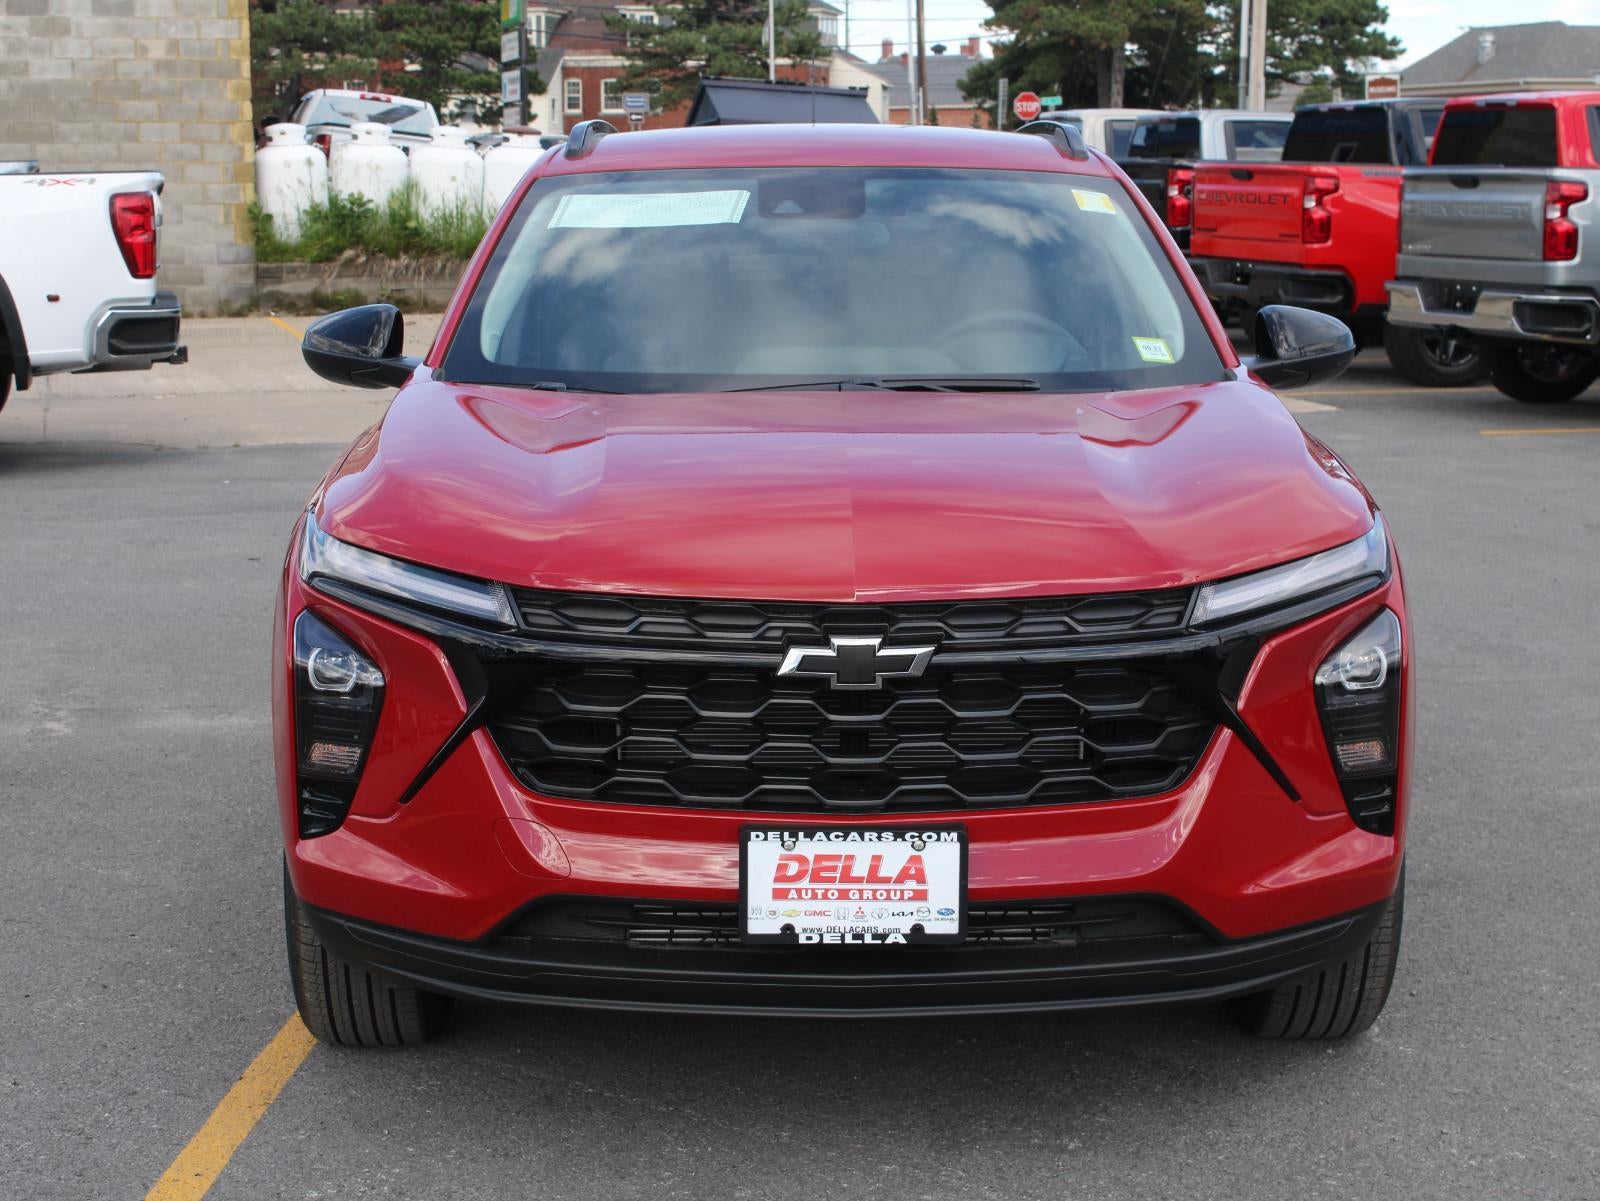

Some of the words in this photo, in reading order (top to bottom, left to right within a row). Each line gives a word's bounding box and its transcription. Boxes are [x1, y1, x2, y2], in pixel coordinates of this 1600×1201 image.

[1016, 101, 1040, 112] STOP
[1197, 190, 1289, 205] CHEVROLET
[1404, 201, 1529, 219] CHEVROLET
[750, 831, 958, 842] DELLACARS.COM
[772, 853, 928, 885] DELLA
[787, 889, 839, 900] AUTO
[848, 888, 914, 900] GROUP
[804, 909, 832, 917] GMC
[801, 925, 901, 934] www.DELLACARS.com
[799, 933, 908, 944] DELLA
